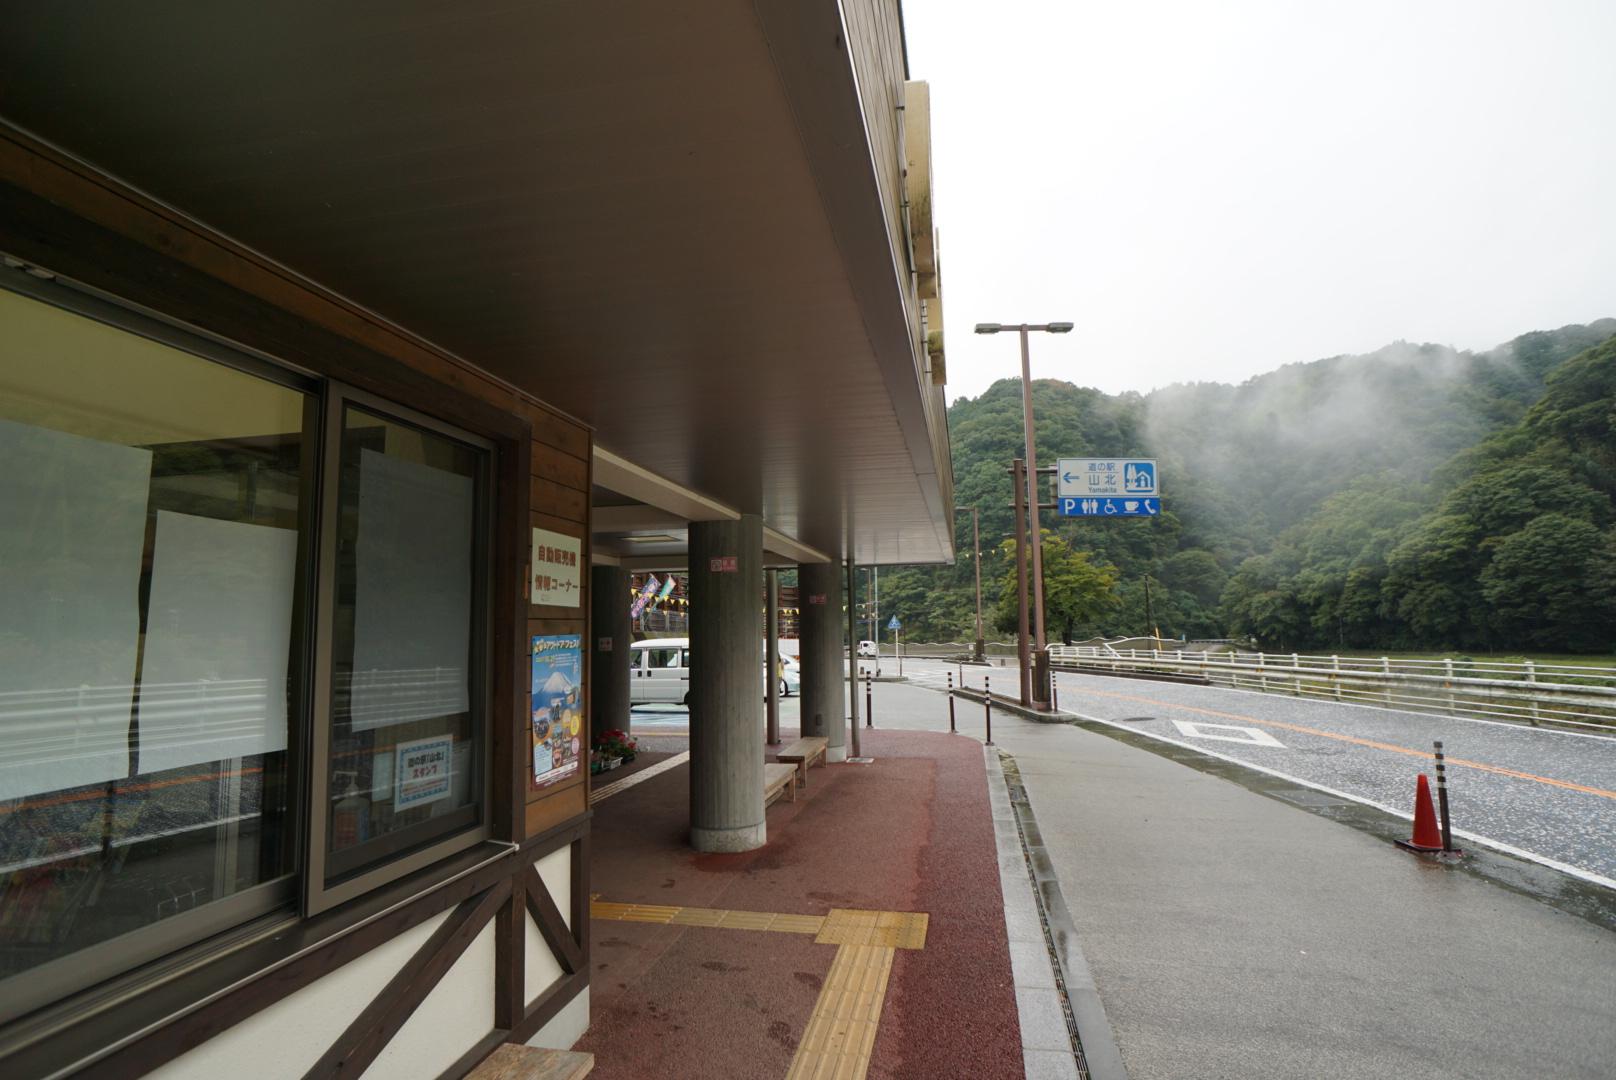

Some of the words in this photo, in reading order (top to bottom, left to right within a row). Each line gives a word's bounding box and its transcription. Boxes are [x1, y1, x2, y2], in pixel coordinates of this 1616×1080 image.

[1088, 463, 1116, 472] 道の駅
[1089, 474, 1117, 486] 山北
[538, 544, 576, 567] 自動販売機
[535, 574, 578, 592] 情報コーナー
